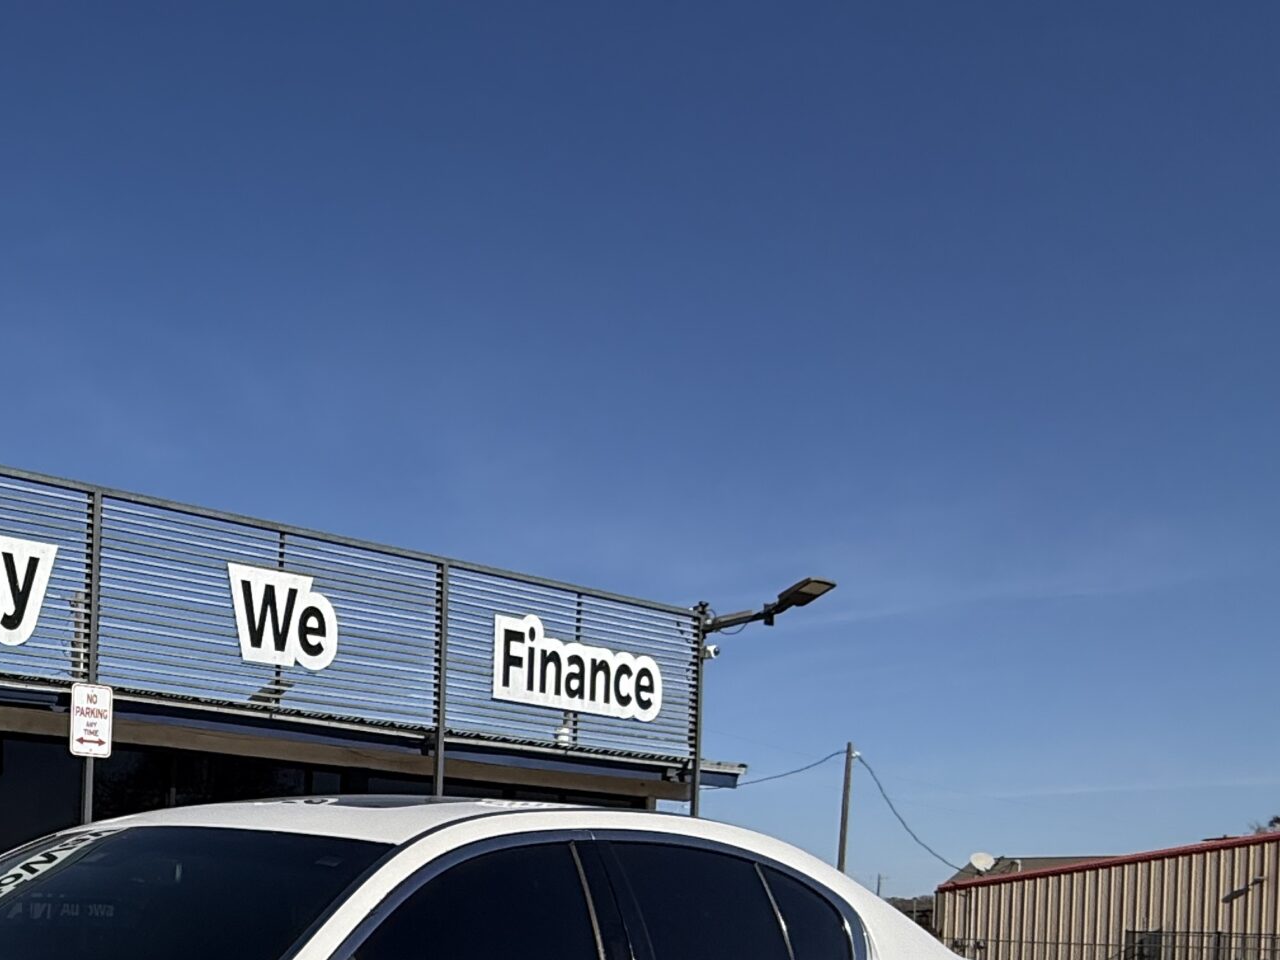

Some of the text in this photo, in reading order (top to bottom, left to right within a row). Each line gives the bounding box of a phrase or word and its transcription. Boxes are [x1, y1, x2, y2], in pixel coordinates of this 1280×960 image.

[241, 579, 327, 657] We
[503, 625, 655, 710] Finance
[86, 693, 98, 705] NO
[75, 706, 109, 720] PARKING
[83, 728, 99, 737] TIME
